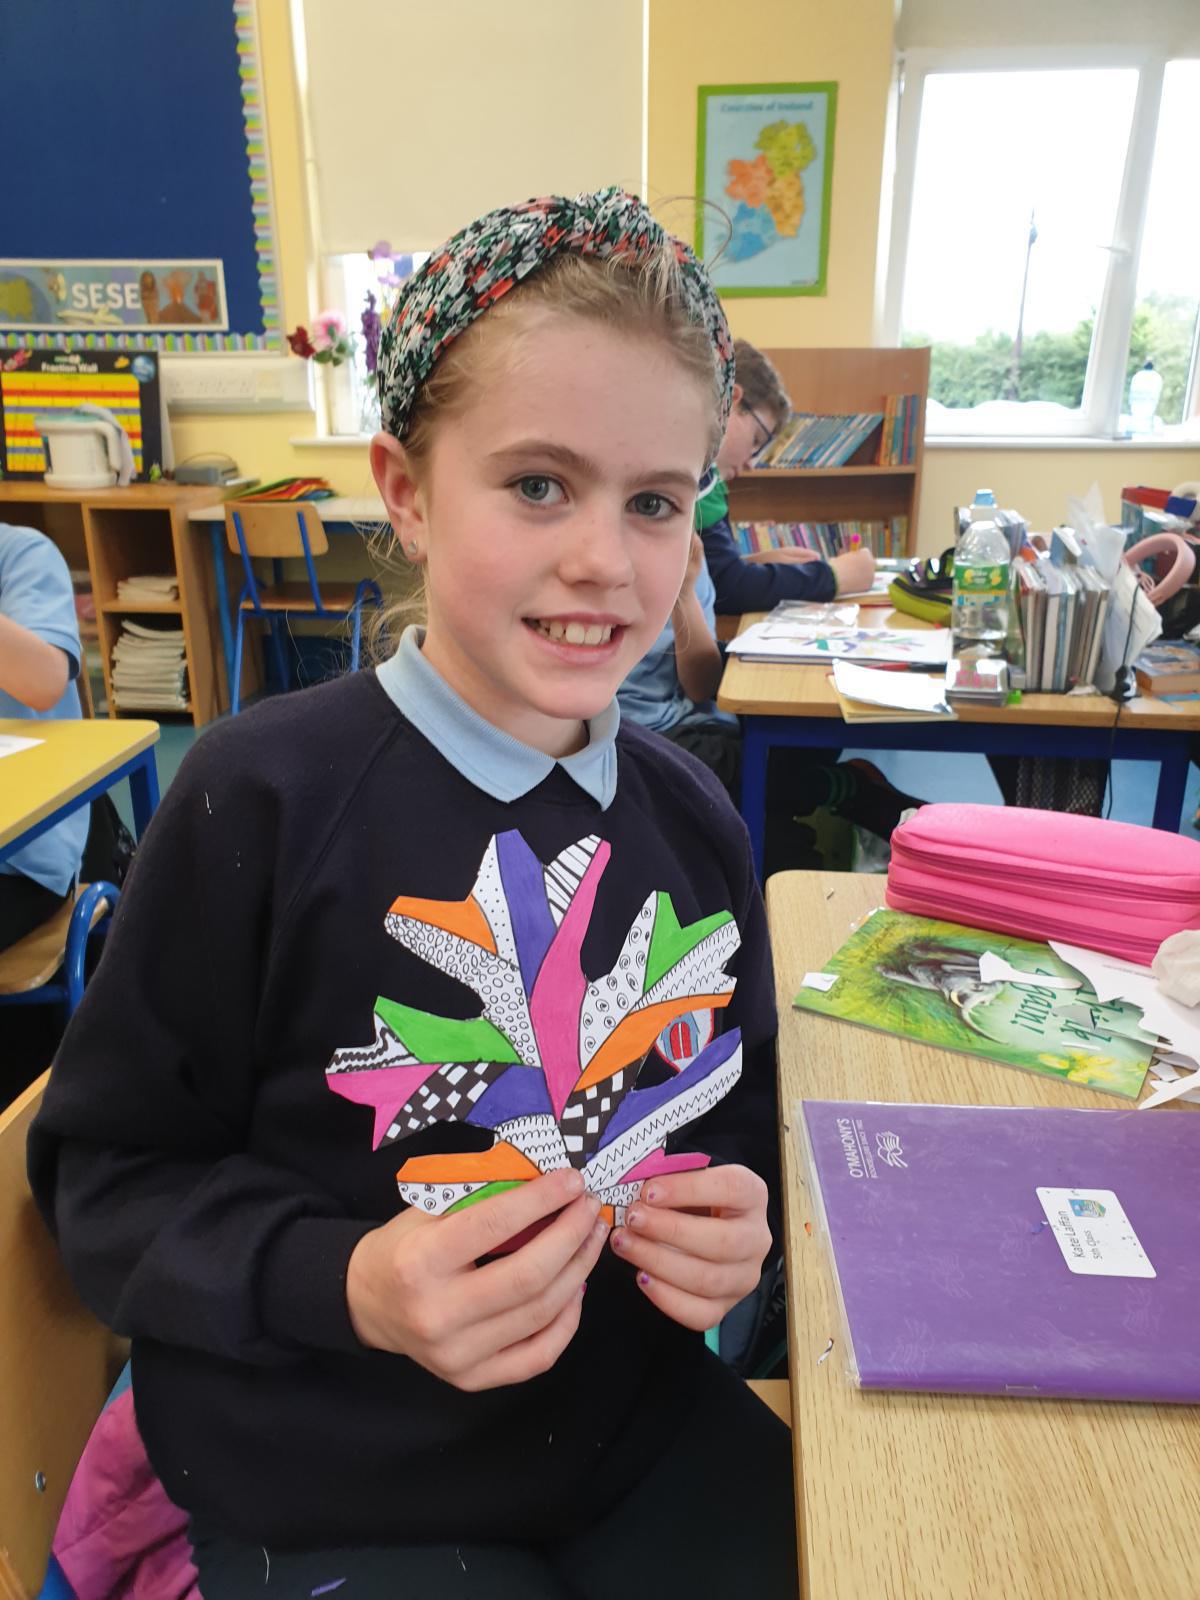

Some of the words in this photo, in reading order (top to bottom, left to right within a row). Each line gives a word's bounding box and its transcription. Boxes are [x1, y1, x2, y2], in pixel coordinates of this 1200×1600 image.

[778, 100, 813, 111] Ireland
[71, 282, 142, 309] SESE
[41, 361, 77, 374] Fraction
[78, 362, 98, 374] Wall
[1009, 968, 1058, 1035] gain!
[1058, 1211, 1076, 1236] Laffan
[1070, 1237, 1085, 1258] Kate
[1083, 1229, 1097, 1247] Class
